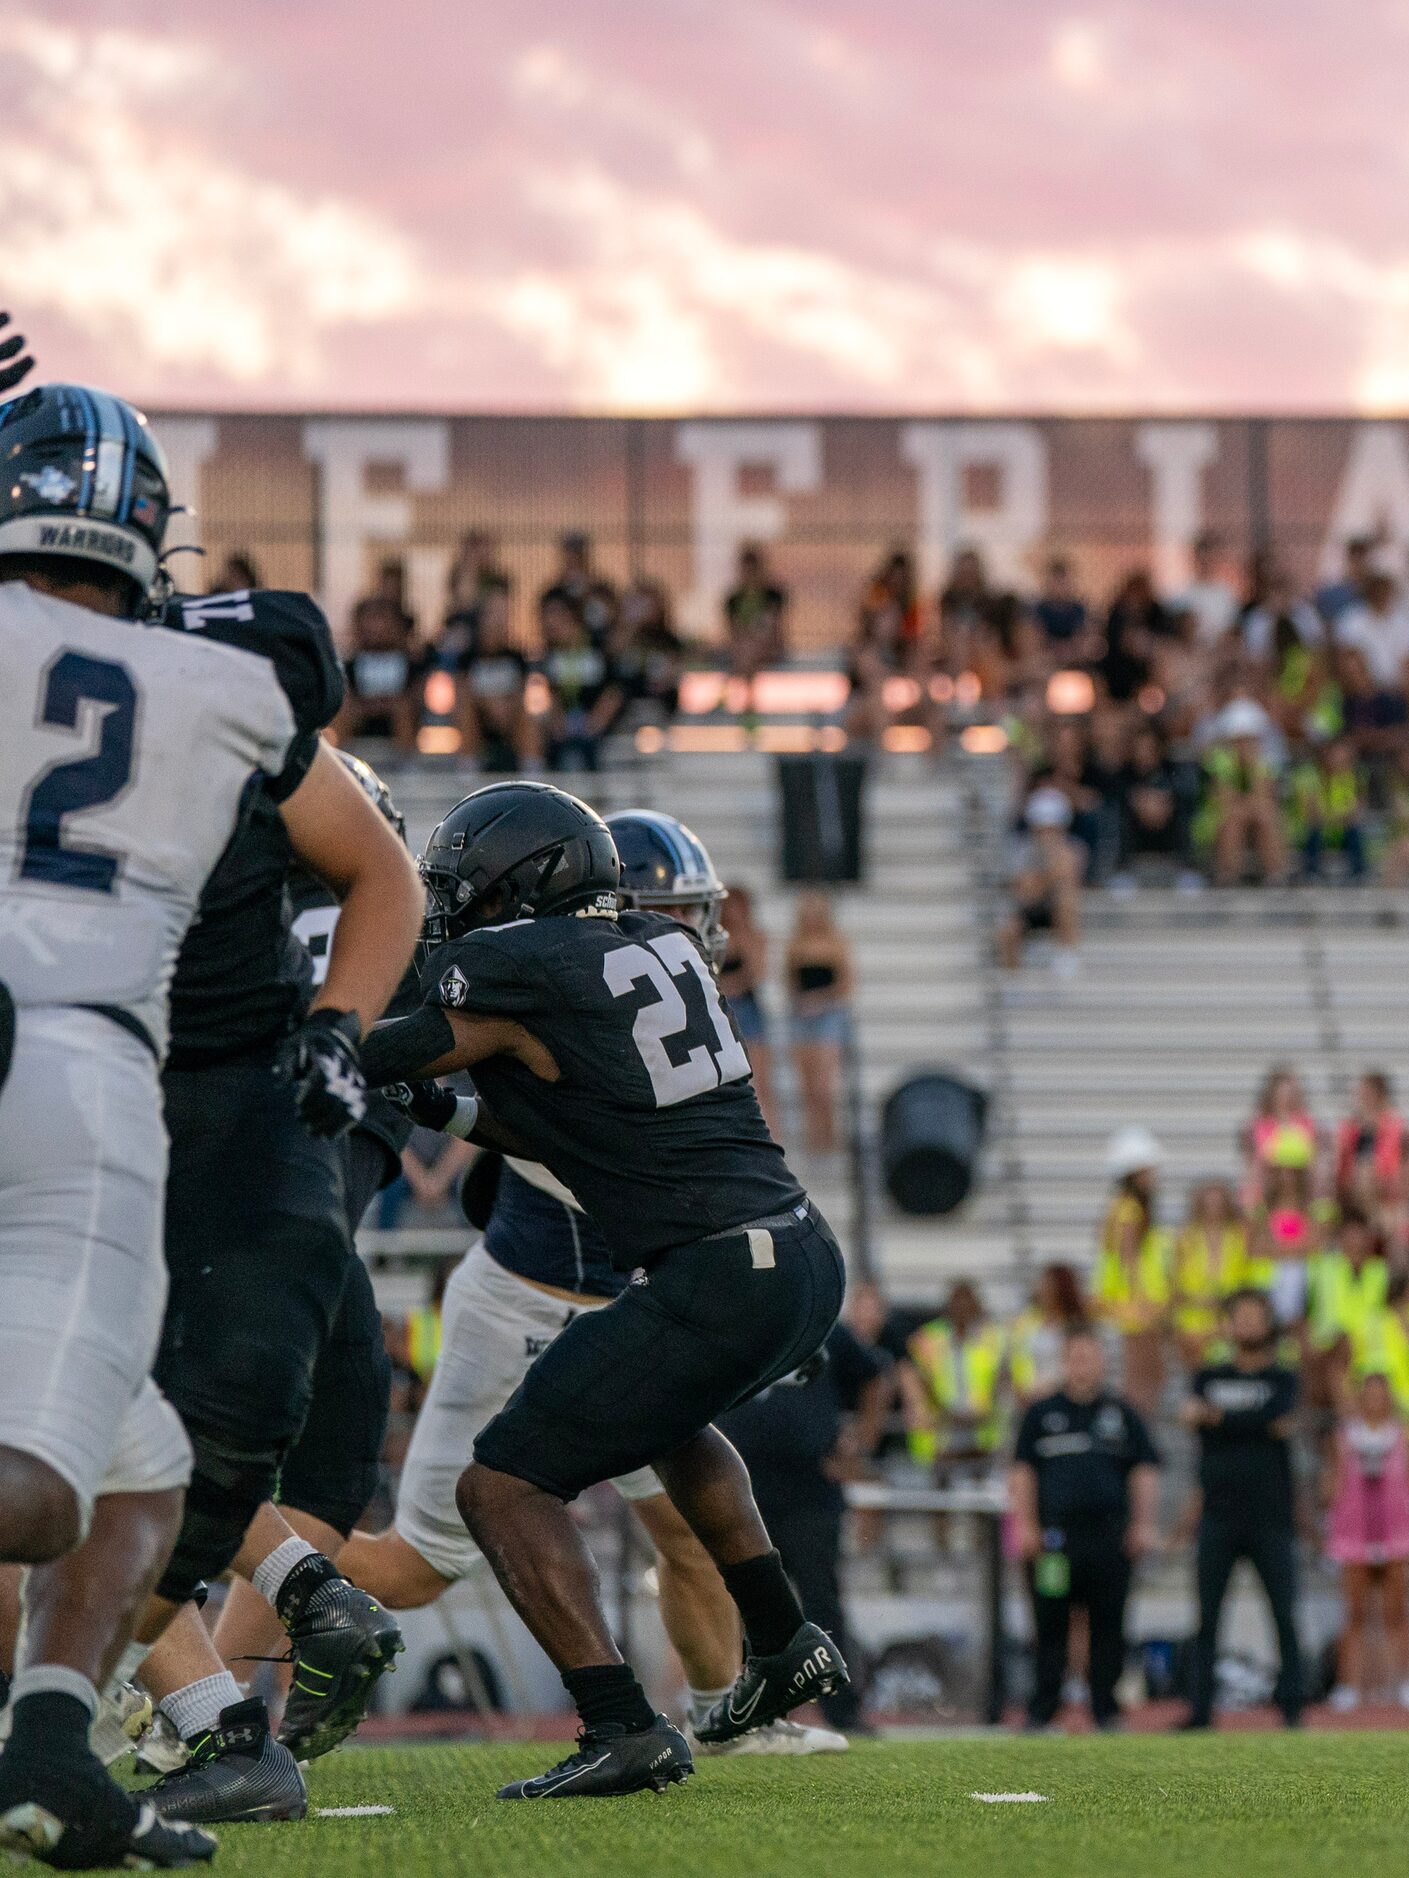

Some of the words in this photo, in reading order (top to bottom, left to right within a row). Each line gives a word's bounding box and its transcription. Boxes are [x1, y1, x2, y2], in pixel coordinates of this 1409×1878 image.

[9, 644, 146, 898] 2
[602, 931, 753, 1108] 27
[648, 1746, 673, 1771] VAPOR
